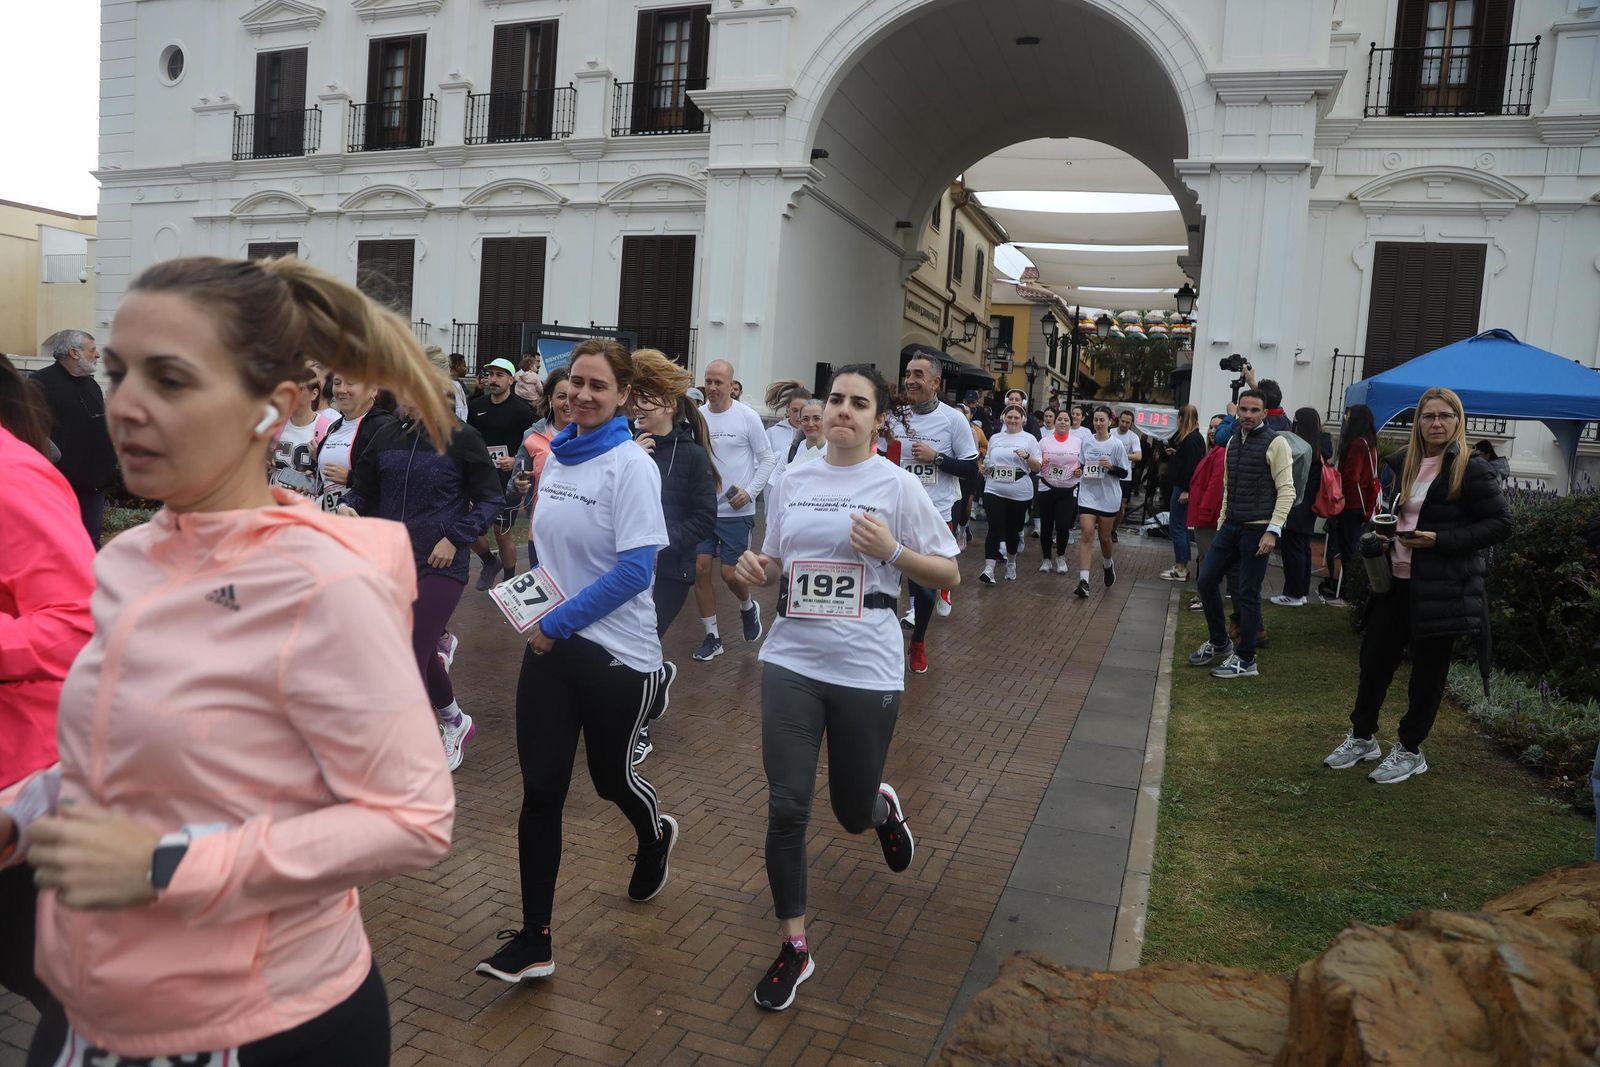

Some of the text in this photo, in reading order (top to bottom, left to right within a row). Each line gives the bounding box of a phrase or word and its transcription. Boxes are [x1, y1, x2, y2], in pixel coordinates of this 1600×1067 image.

[905, 464, 934, 476] 105
[996, 469, 1013, 477] 135
[1053, 467, 1063, 476] 94
[510, 573, 549, 606] 87
[796, 574, 855, 599] 192
